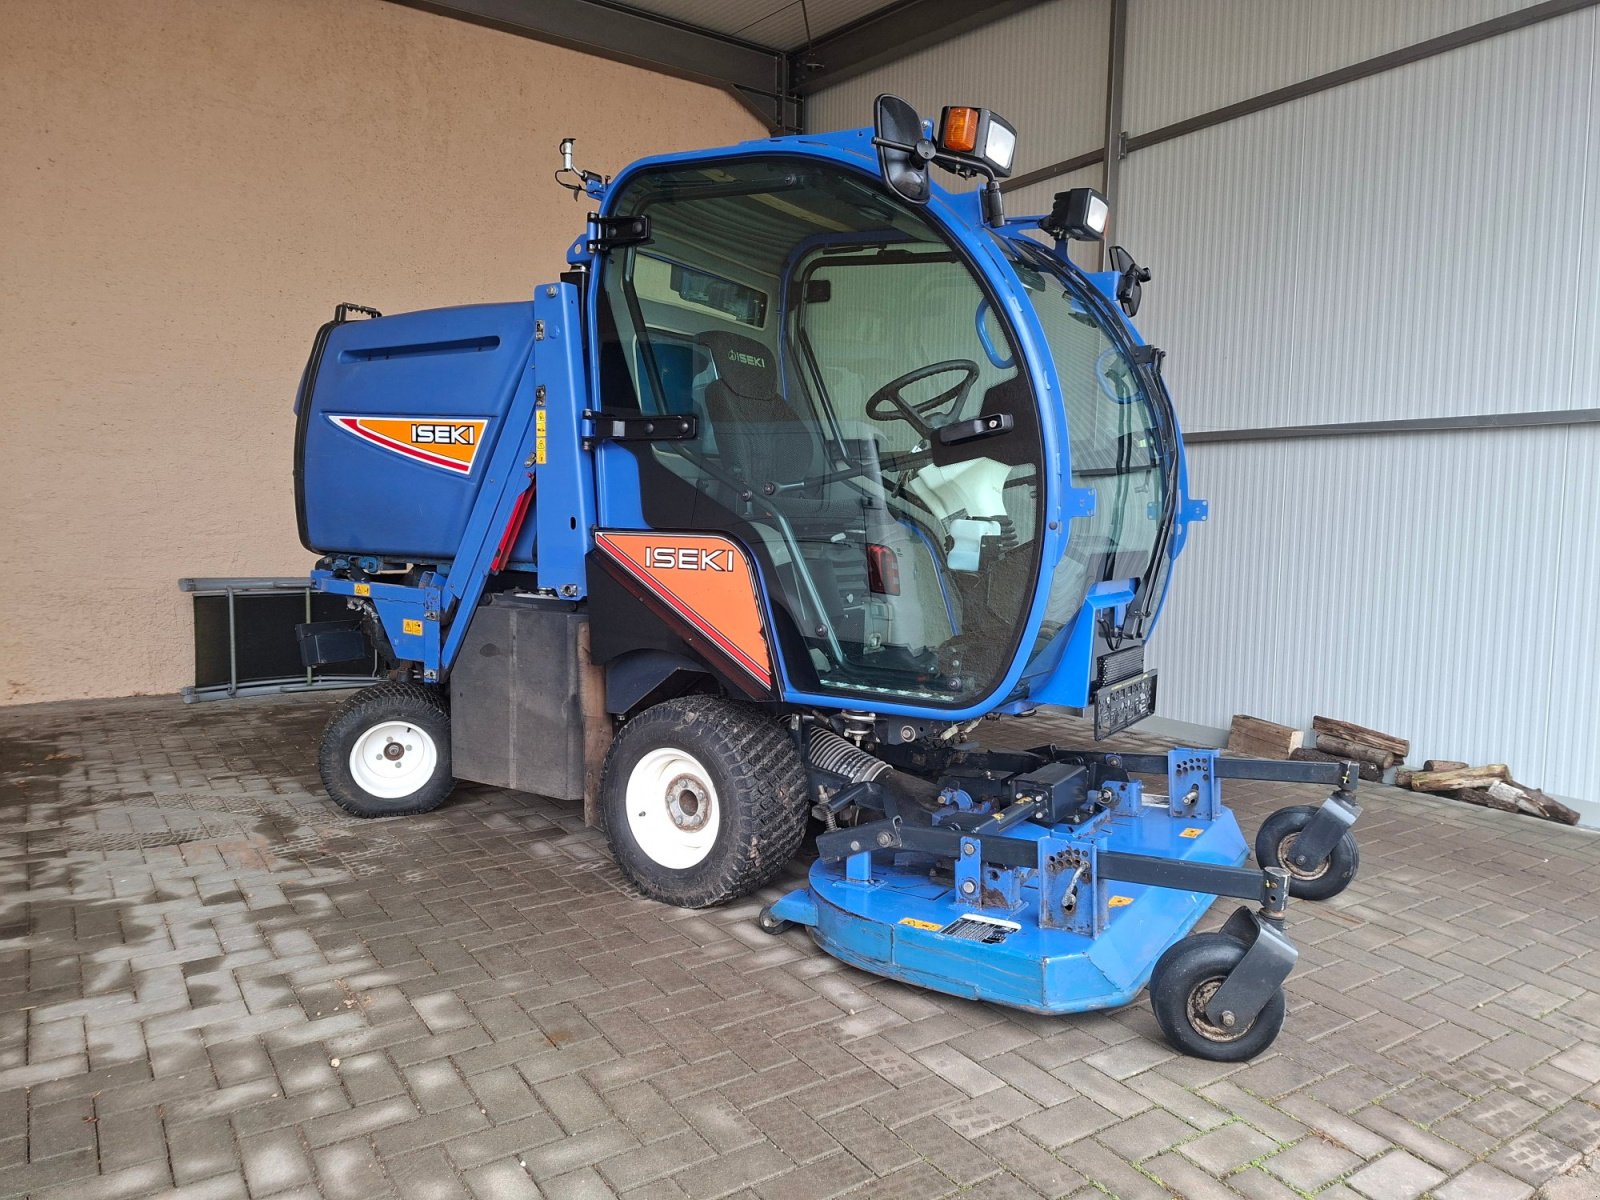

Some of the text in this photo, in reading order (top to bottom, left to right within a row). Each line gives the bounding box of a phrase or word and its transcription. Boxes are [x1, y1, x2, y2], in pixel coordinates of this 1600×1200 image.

[736, 352, 766, 368] ISEKI
[411, 424, 474, 445] ISEKI
[645, 547, 734, 572] ISEKI
